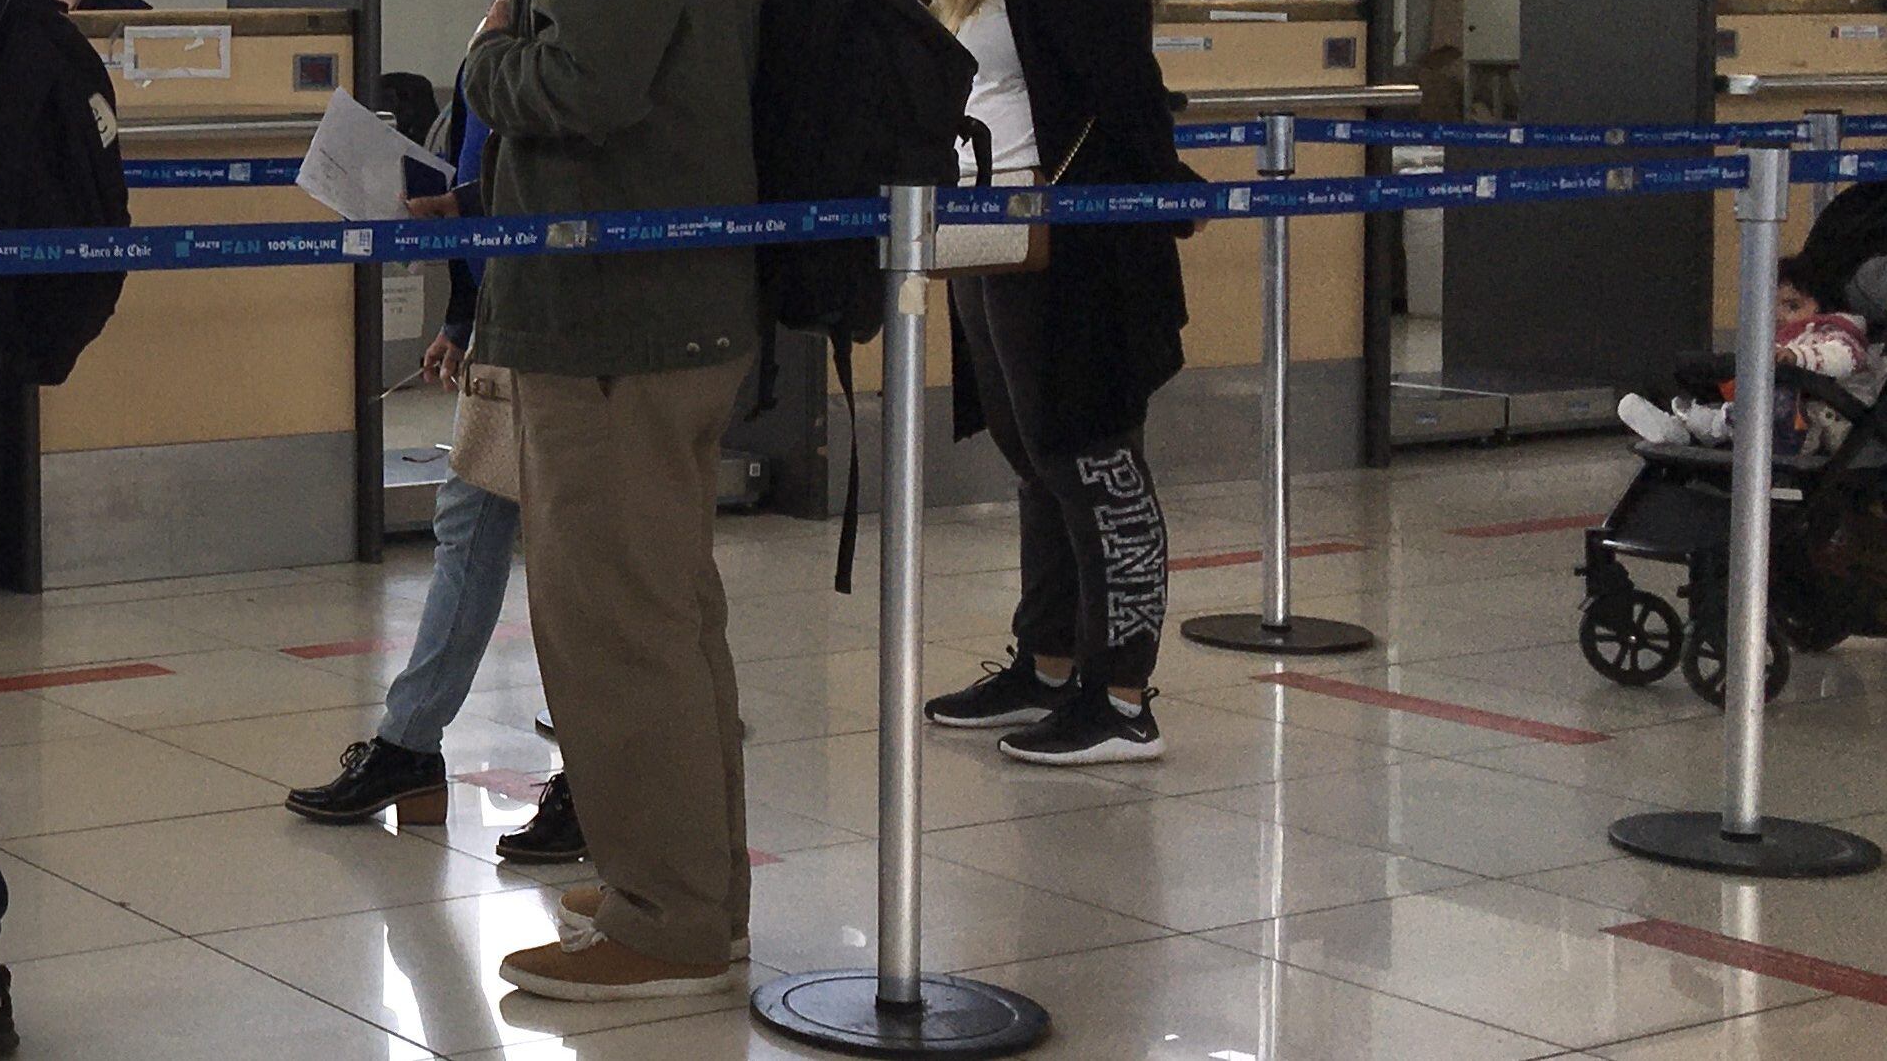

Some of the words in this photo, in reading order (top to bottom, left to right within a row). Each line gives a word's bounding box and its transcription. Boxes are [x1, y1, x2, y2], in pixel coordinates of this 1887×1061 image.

[221, 240, 261, 254] FAN
[267, 240, 296, 251] 100%
[298, 240, 337, 250] ONLINE
[419, 235, 458, 249] FAN
[472, 233, 501, 246] Banco
[515, 232, 538, 245] Chile
[20, 245, 61, 259] FAN
[79, 243, 111, 258] Banco
[127, 243, 152, 257] Chile
[1076, 449, 1167, 647] PINK
